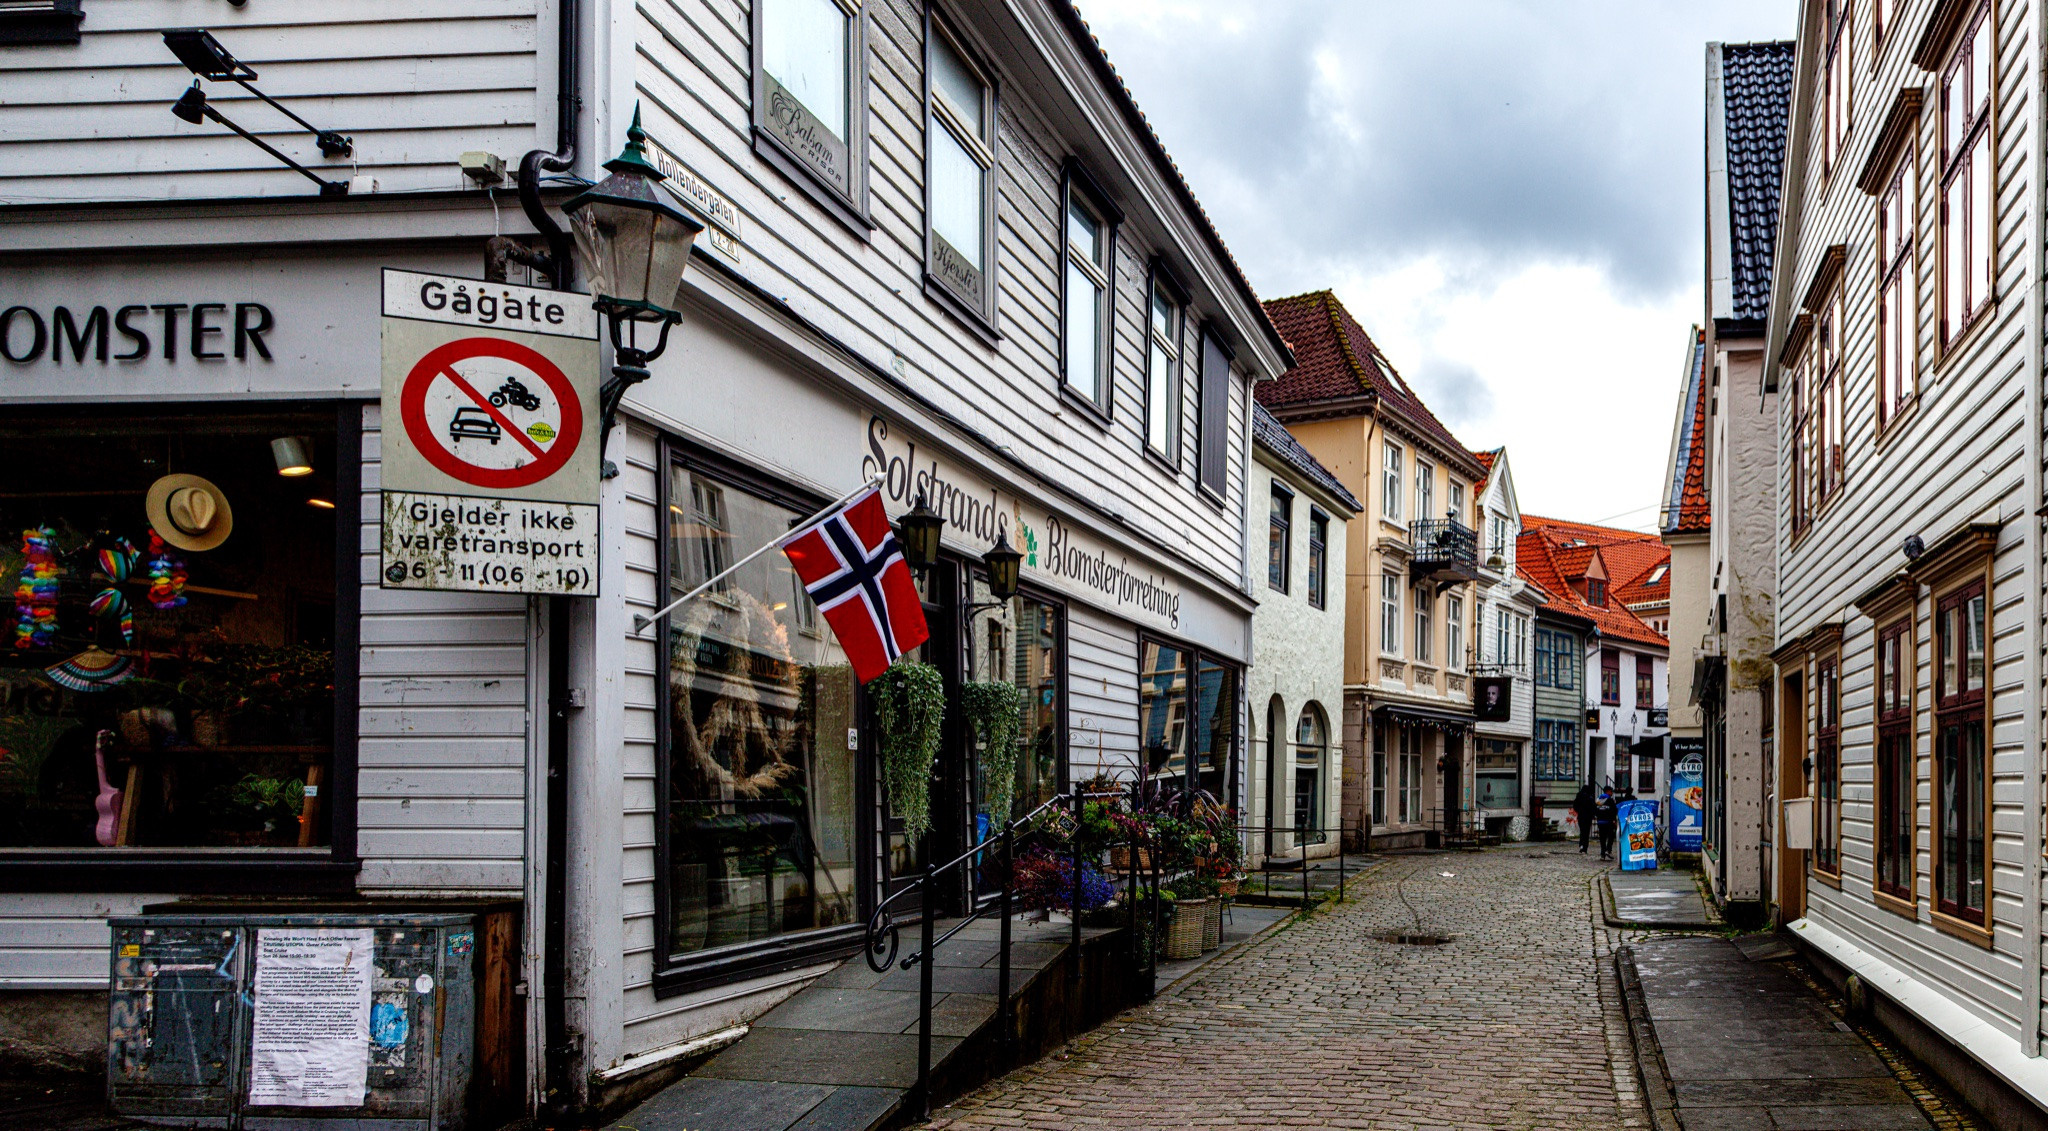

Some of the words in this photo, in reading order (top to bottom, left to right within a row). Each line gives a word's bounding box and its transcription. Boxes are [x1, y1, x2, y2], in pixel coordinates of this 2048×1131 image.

[788, 106, 834, 165] Balsam
[800, 143, 842, 182] FRISØR
[420, 282, 565, 324] Gågate
[410, 502, 510, 528] Gjelder
[522, 509, 575, 530] ikke
[862, 415, 1008, 546] Solstrands
[1044, 514, 1180, 630] Blomsterforretning
[399, 533, 584, 559] varetransport
[556, 566, 589, 589] 10)
[1629, 813, 1652, 822] GYROS
